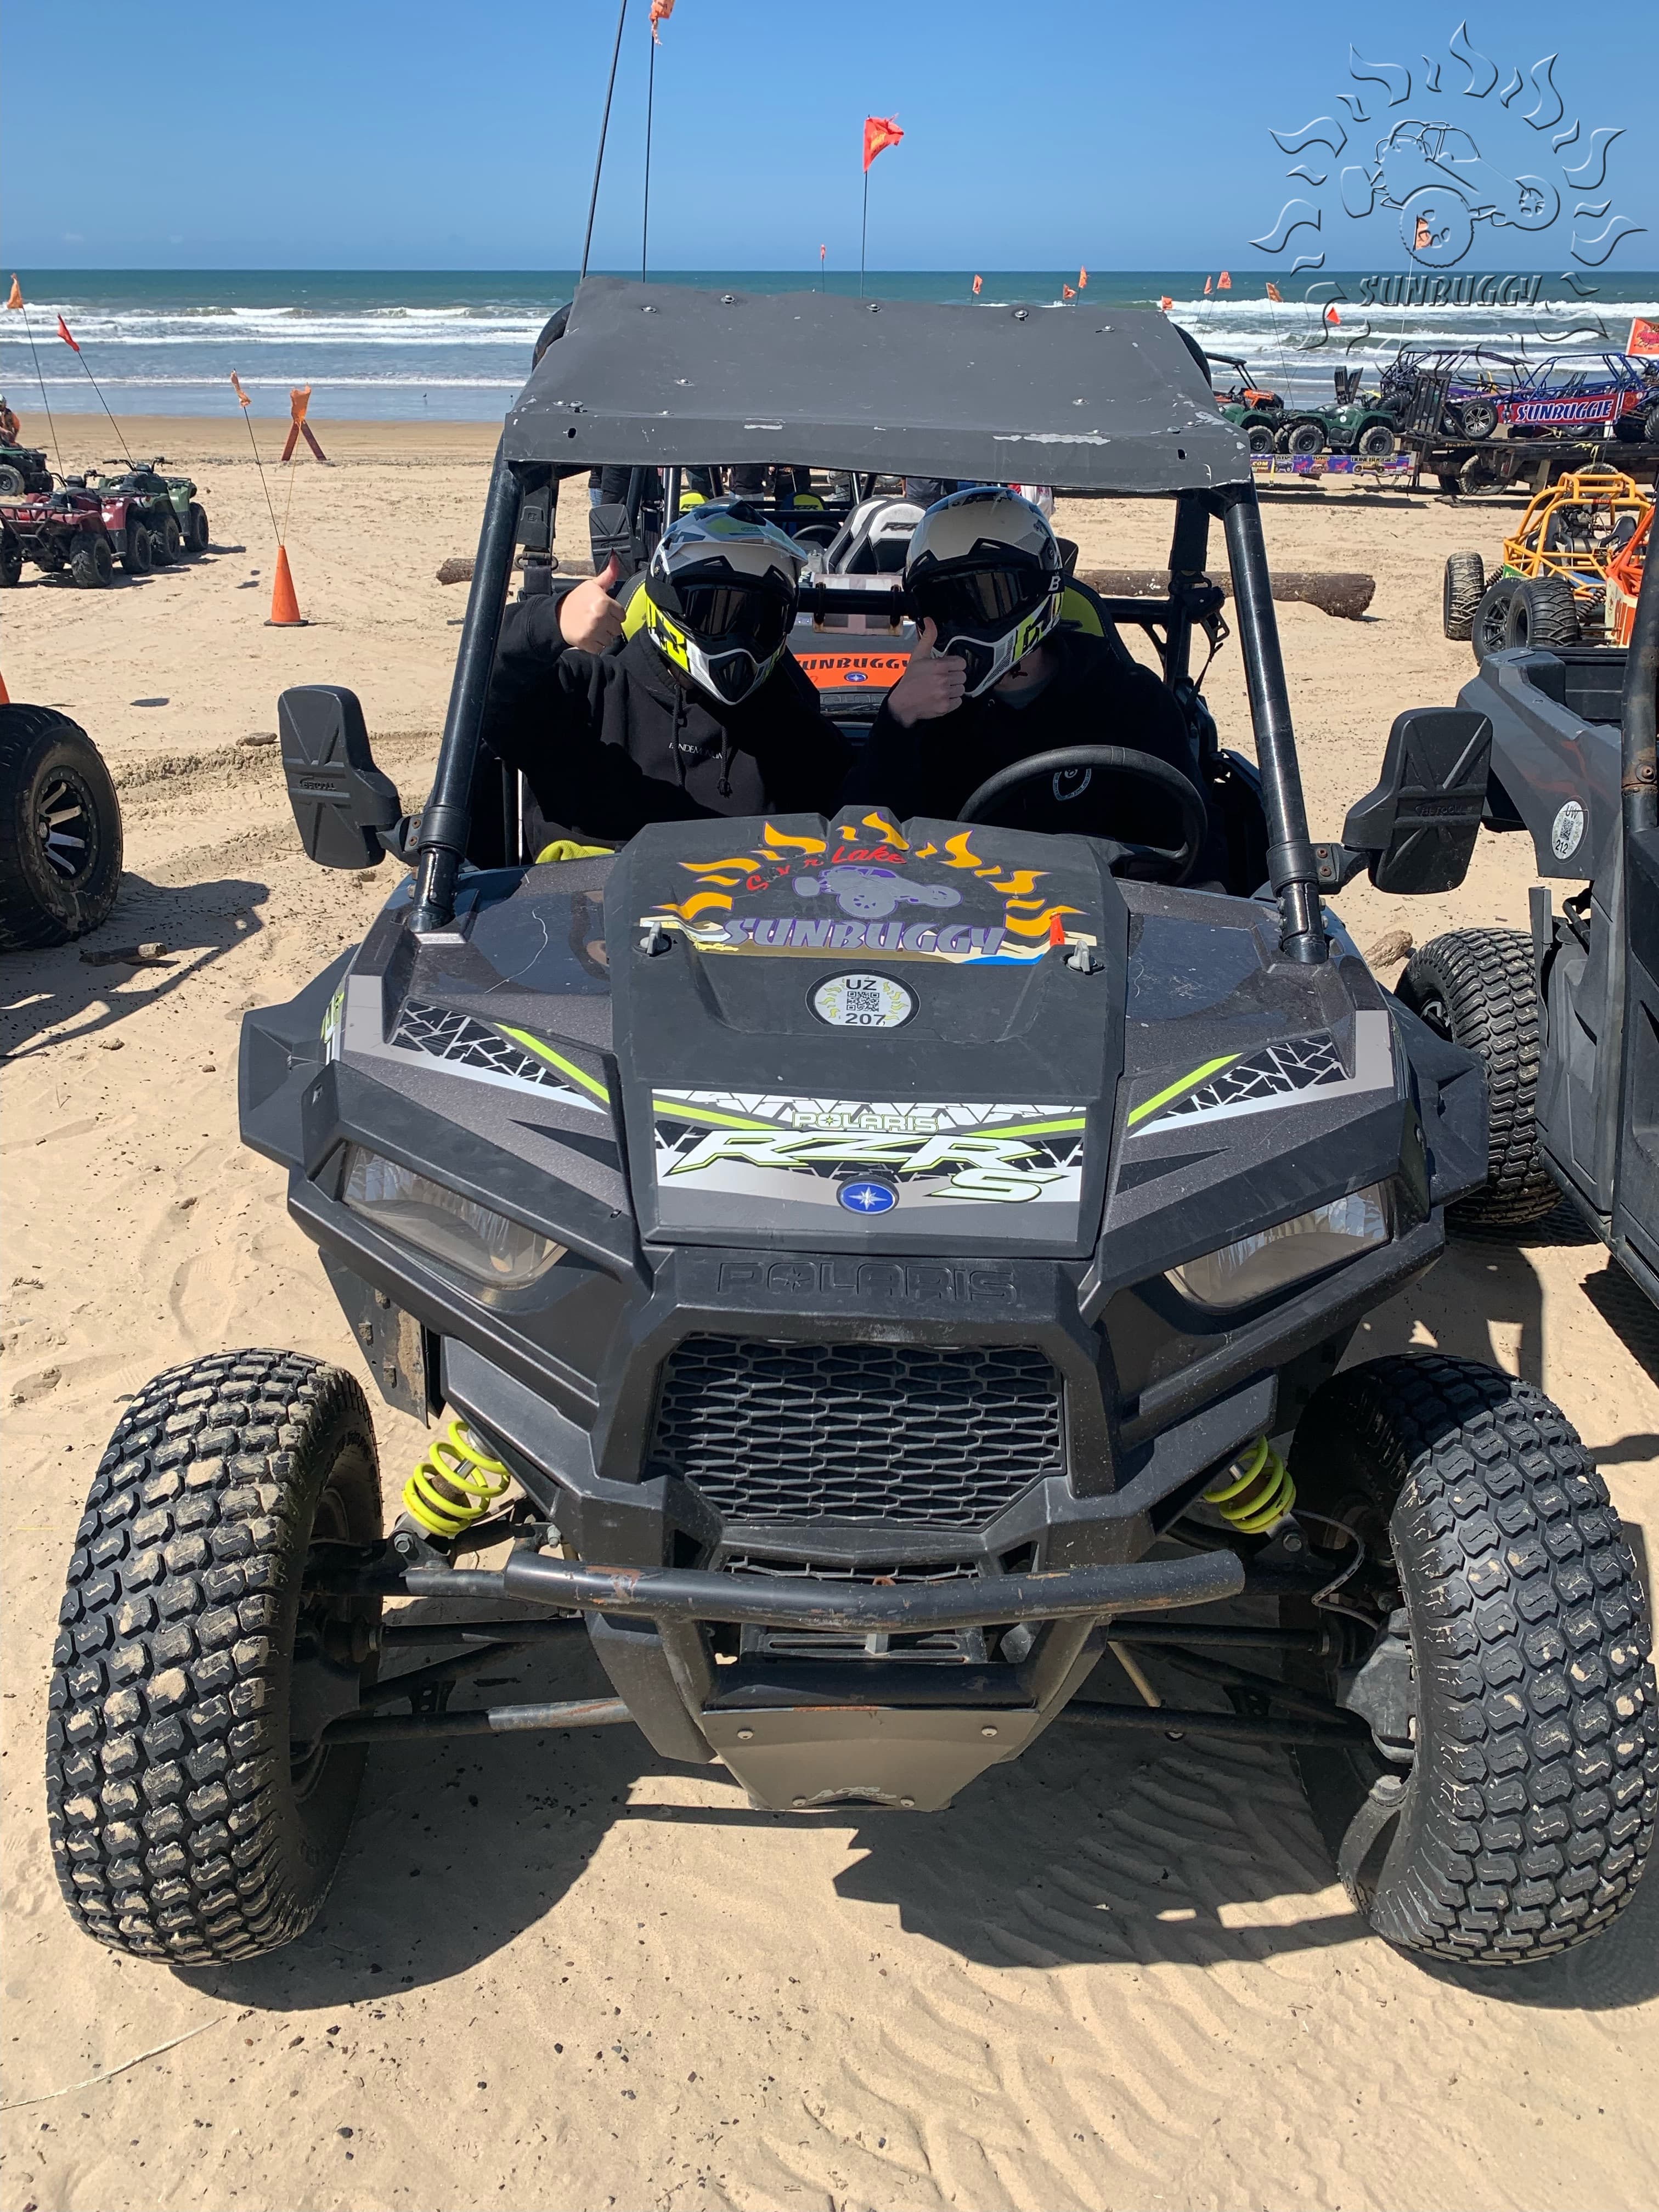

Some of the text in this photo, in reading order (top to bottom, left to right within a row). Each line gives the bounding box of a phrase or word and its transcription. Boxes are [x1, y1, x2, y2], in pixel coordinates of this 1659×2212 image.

[1516, 399, 1615, 422] SUNBUGGIE
[798, 658, 909, 670] UNBUGG
[1565, 805, 1579, 819] UW
[831, 845, 907, 864] Lake
[1555, 839, 1568, 854] 212
[721, 918, 1008, 956] SUNBUGGY
[846, 979, 877, 991] UZ
[845, 1013, 887, 1025] 207
[792, 1111, 939, 1133] POLARIS
[663, 1129, 1045, 1178] RZR
[717, 1261, 1018, 1305] POLARIS
